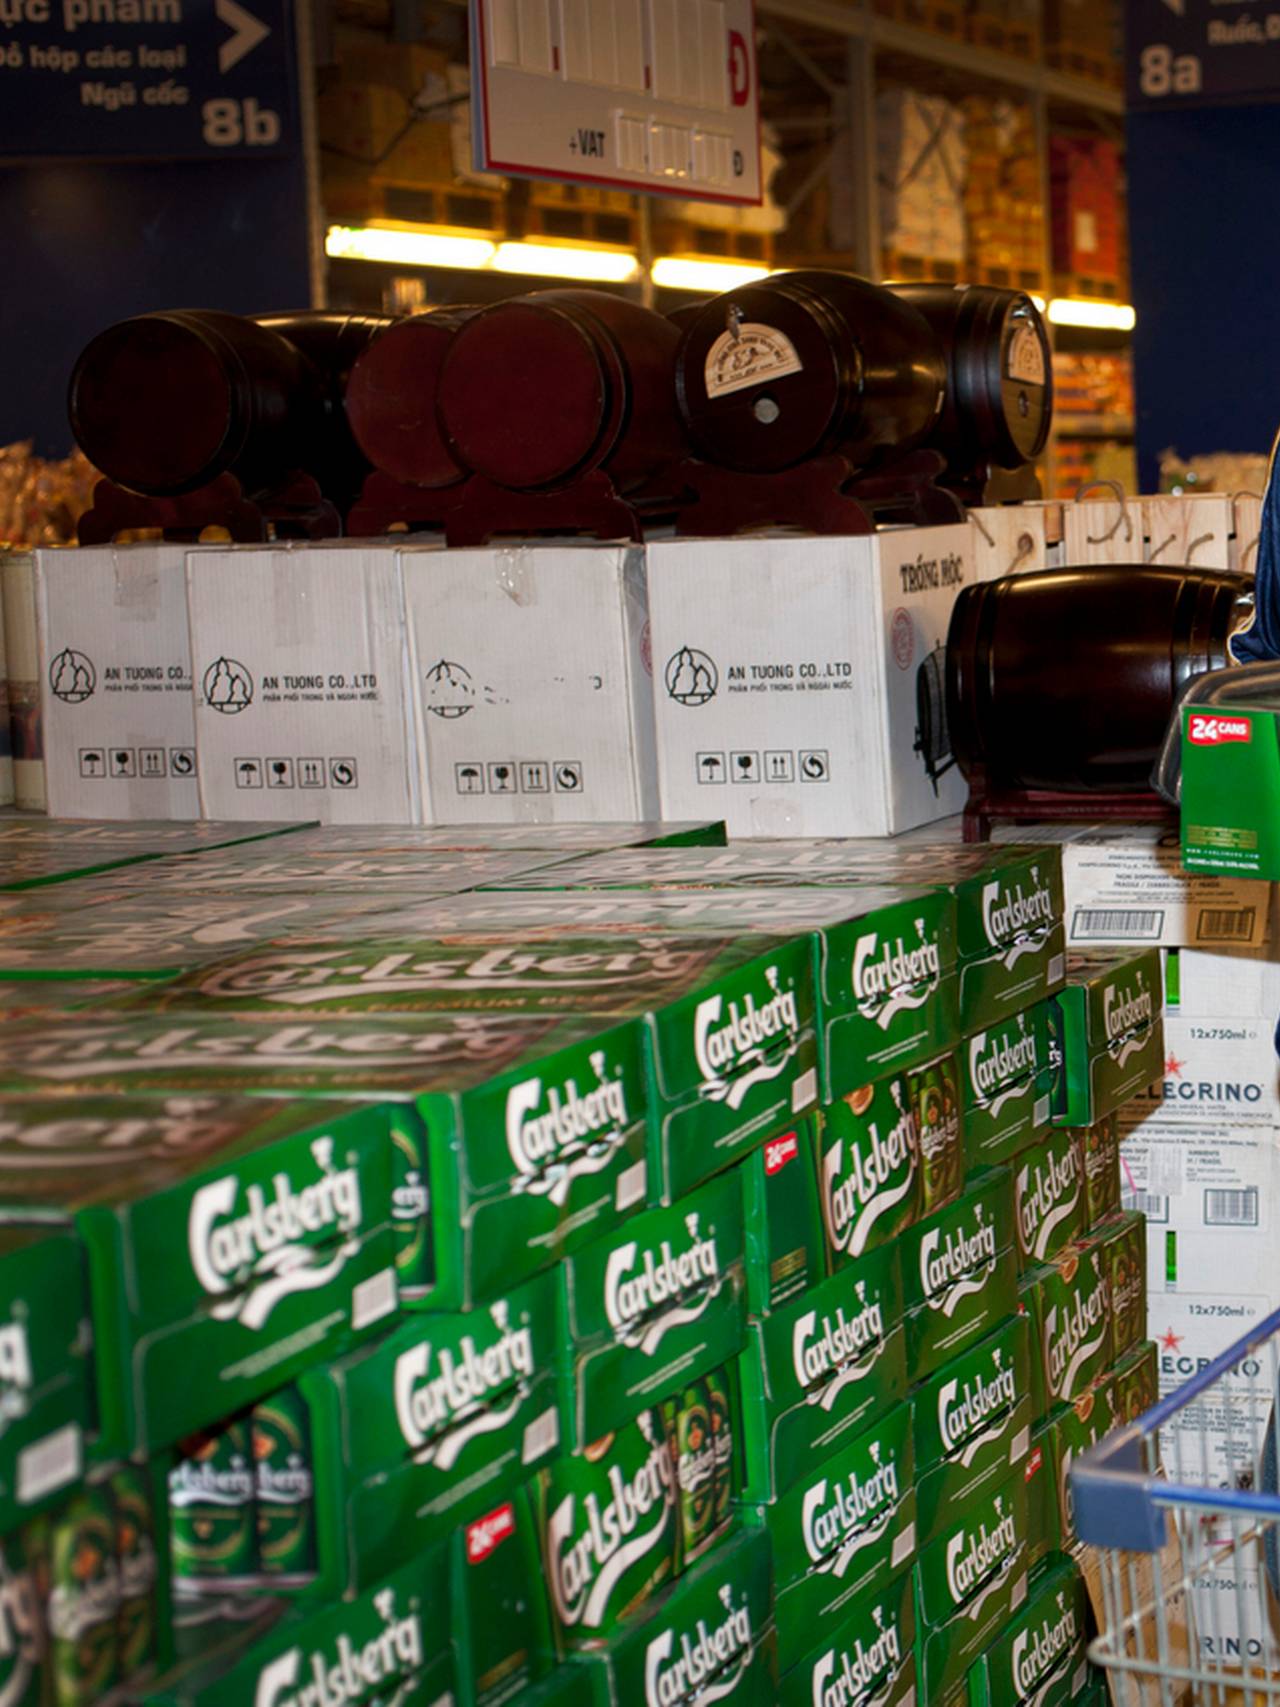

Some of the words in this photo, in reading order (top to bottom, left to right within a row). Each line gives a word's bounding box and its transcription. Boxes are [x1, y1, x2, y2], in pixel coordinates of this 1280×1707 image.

[85, 46, 132, 68] các
[1140, 45, 1201, 96] 8a
[202, 98, 281, 146] 8b
[105, 667, 120, 680] AN
[125, 667, 163, 680] TUONG
[262, 677, 278, 689] AN
[283, 675, 324, 688] TUONG
[728, 666, 745, 679] AN
[750, 665, 794, 679] TUONG
[1192, 718, 1217, 740] 24
[1218, 722, 1246, 736] CANS
[983, 867, 1052, 952] Carlsberg
[203, 938, 708, 998] Carlsberg
[852, 919, 939, 1003] Carlsberg
[1104, 972, 1152, 1050] Carlsberg
[695, 966, 798, 1083] Carlsberg
[969, 1014, 1037, 1099] Carlsberg
[1190, 1027, 1247, 1040] 12x750ml
[506, 1053, 626, 1172] Carlsberg
[1135, 1081, 1262, 1101] LEGRINO
[189, 1136, 362, 1294] Carlsberg
[823, 1082, 919, 1252] Carlsberg
[1017, 1131, 1085, 1256] Carlsberg
[606, 1213, 718, 1328] Carlsberg
[920, 1204, 996, 1304] Carlsberg
[395, 1300, 532, 1448] Carlsberg
[793, 1281, 884, 1392] Carlsberg
[1044, 1254, 1110, 1394] Carlsberg
[939, 1349, 1016, 1459] Carlsberg
[170, 1457, 251, 1494] rlsberg
[548, 1409, 673, 1626] Carlsberg
[802, 1442, 898, 1562] Carlsberg
[947, 1497, 1015, 1604] Carlsberg
[257, 1589, 422, 1707] Carlsberg
[646, 1584, 752, 1706] Carlsberg
[813, 1606, 899, 1707] Carlsberg
[1013, 1593, 1075, 1699] Carlsberg
